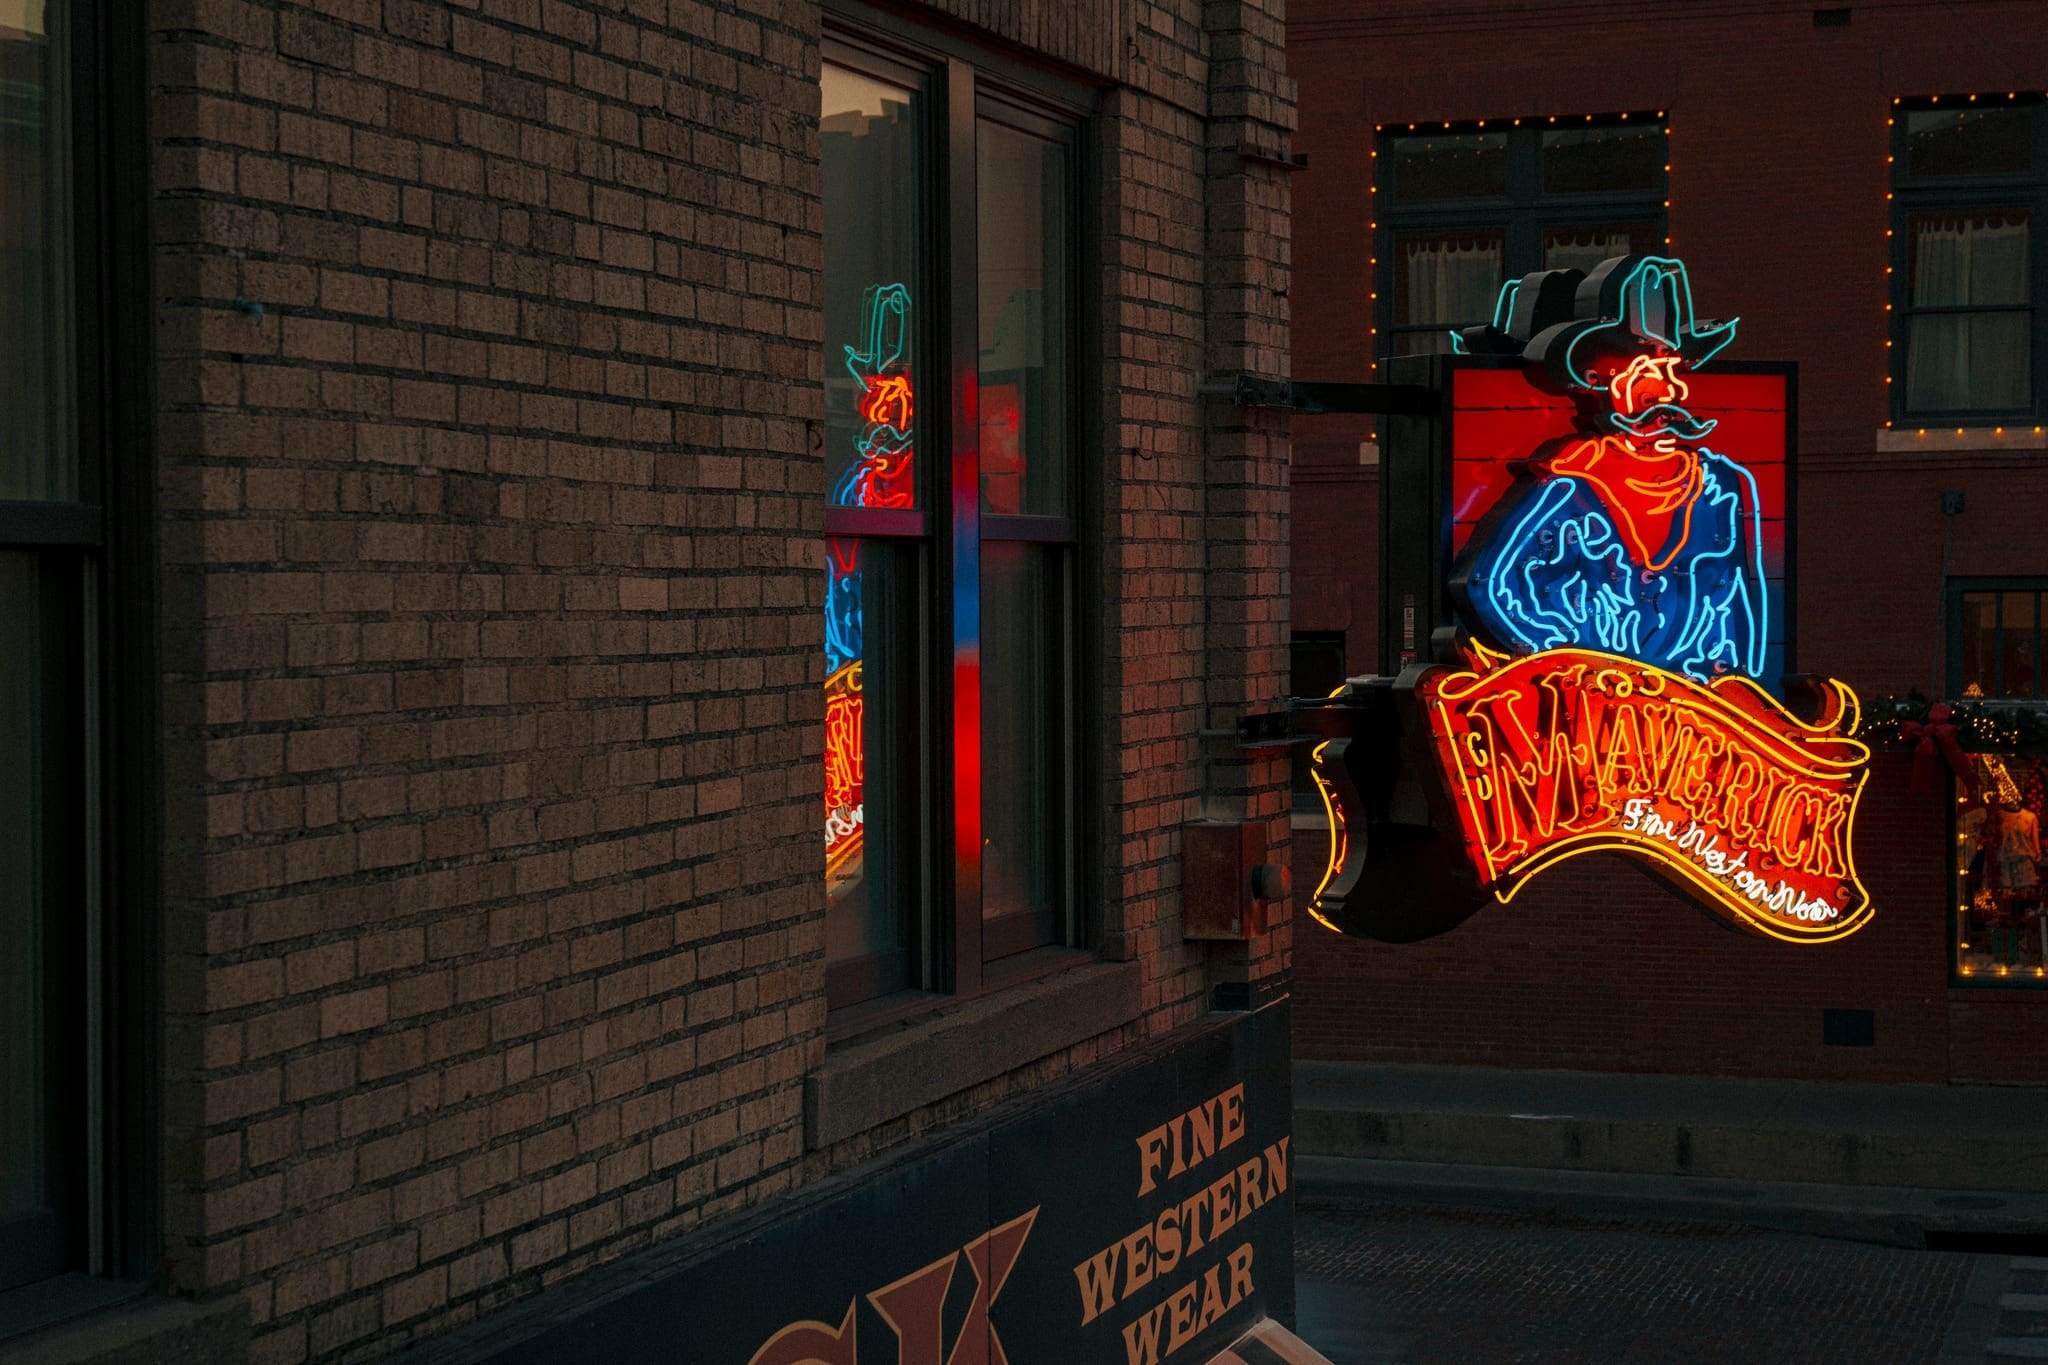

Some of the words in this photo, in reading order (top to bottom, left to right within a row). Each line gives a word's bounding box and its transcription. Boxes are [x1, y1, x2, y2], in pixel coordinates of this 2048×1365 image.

[1466, 664, 1852, 878] MAVERICK
[1623, 798, 1678, 841] Fine
[1135, 1081, 1246, 1199] FINE
[1073, 1135, 1291, 1328] WESTERN
[1121, 1241, 1256, 1365] WEAR
